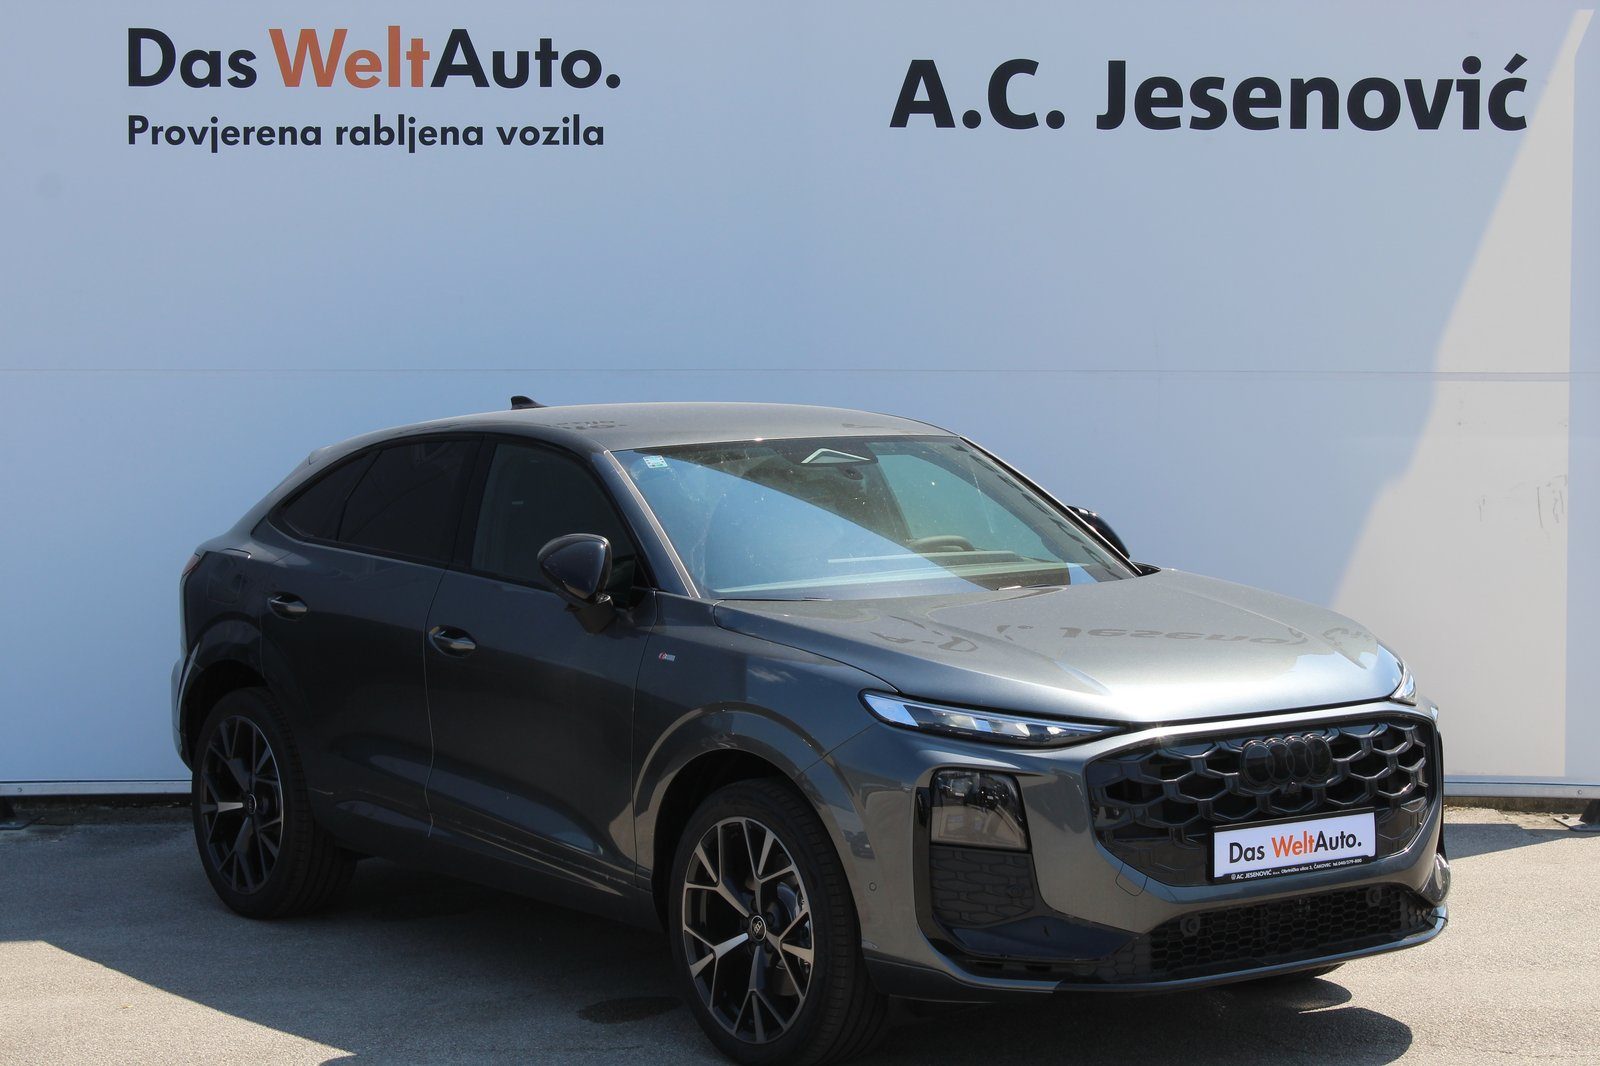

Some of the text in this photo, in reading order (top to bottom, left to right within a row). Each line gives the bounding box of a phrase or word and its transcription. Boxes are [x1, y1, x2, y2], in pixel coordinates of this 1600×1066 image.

[128, 26, 621, 89] Das WeltAuto.
[890, 54, 1528, 131] A.C. Jesenović
[128, 114, 604, 153] Provjerena rabljena vozila
[1229, 830, 1362, 864] Das WeltAuto.
[1245, 869, 1272, 879] JESENOVIĆ
